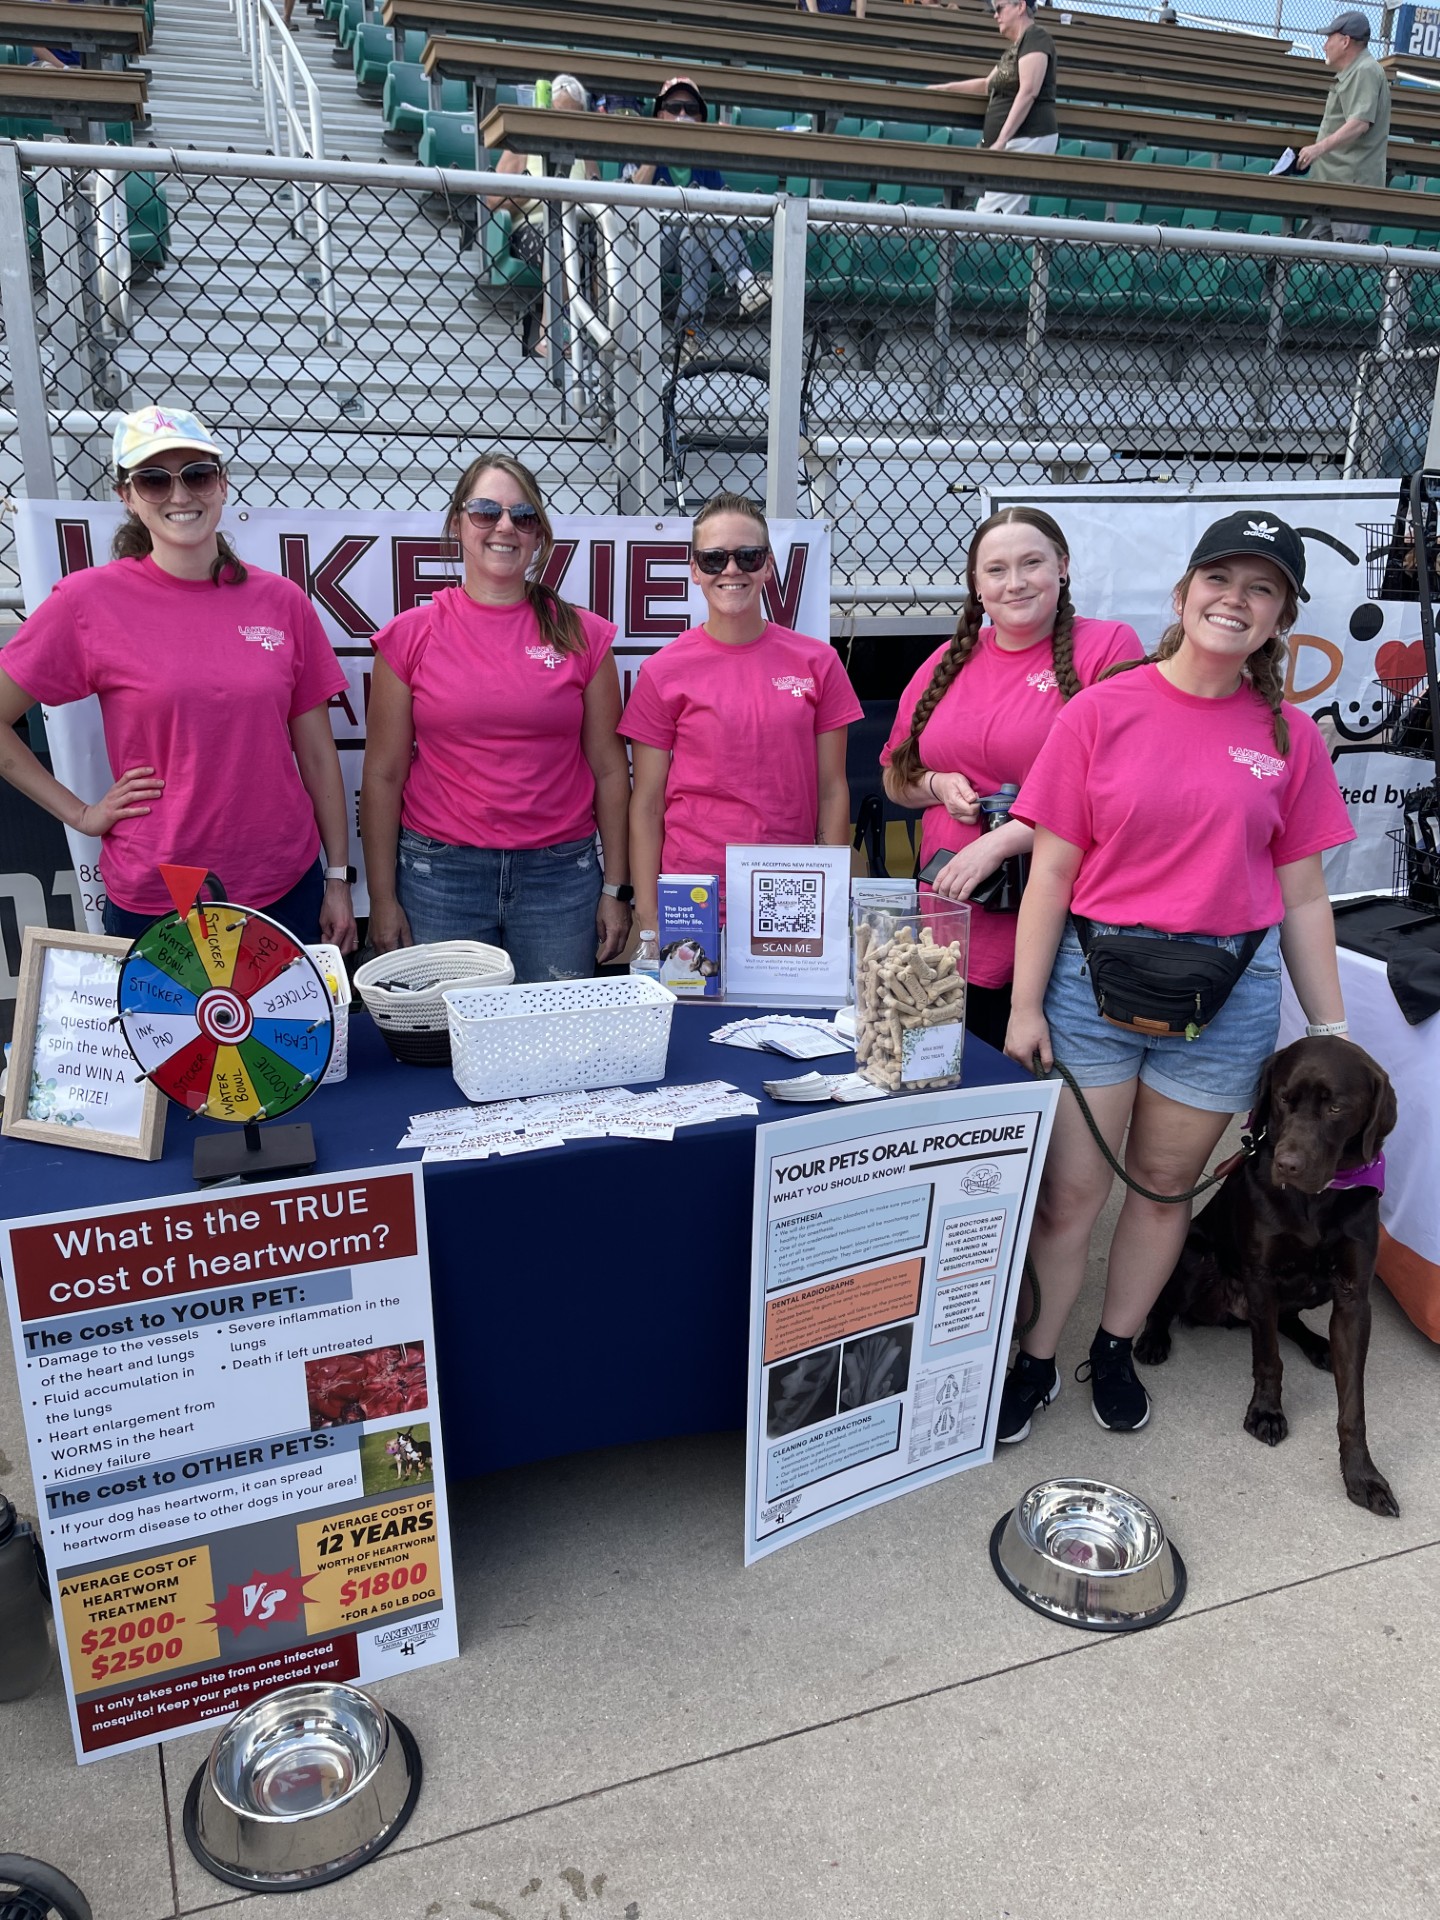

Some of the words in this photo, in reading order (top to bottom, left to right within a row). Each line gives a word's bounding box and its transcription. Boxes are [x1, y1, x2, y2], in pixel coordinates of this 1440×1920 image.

[1408, 22, 1440, 58] 20
[1243, 530, 1275, 542] adidas
[665, 918, 690, 926] healthy
[157, 948, 185, 976] BOWL
[158, 928, 194, 963] WATER
[248, 936, 278, 970] BALL
[762, 943, 792, 953] SCAN
[794, 944, 812, 953] ME
[71, 990, 118, 1008] Answer
[129, 977, 183, 1007] STICKER
[264, 981, 318, 1013] STICKER
[61, 1016, 115, 1033] question
[135, 1024, 155, 1039] INK
[153, 1032, 173, 1049] PAD
[48, 1037, 73, 1052] spin
[77, 1040, 98, 1055] the
[274, 1029, 318, 1056] LEASH
[58, 1063, 81, 1076] and
[86, 1065, 113, 1083] WIN
[116, 1070, 125, 1083] A
[233, 1068, 249, 1102] BOWL
[253, 1057, 294, 1104] KOOZIE
[69, 1086, 109, 1106] PRIZE!
[216, 1073, 235, 1115] WATER
[412, 1106, 468, 1120] LAKEVIEW
[615, 1120, 673, 1128] LAKEVIEW
[428, 1142, 488, 1152] LAKEVIEW
[496, 1130, 554, 1144] LAKEVIEW
[775, 1159, 825, 1184] YOUR
[829, 1149, 868, 1171] PETS
[872, 1140, 918, 1161] ORAL
[922, 1125, 1025, 1152] PROCEDURE
[773, 1188, 803, 1203] WHAT
[806, 1182, 828, 1194] YOU
[830, 1173, 869, 1189] SHOULD
[872, 1164, 905, 1179] KNOW!
[53, 1221, 153, 1258] What
[164, 1216, 192, 1241] is
[203, 1208, 259, 1234] the
[270, 1188, 367, 1224] TRUE
[774, 1212, 822, 1229] ANESTHESIA
[49, 1267, 130, 1302] cost
[142, 1257, 175, 1285] of
[188, 1224, 389, 1278] heartworm?
[772, 1295, 799, 1309] DENTAL
[801, 1278, 854, 1300] RADIOGRAPHS
[23, 1330, 72, 1349] The
[80, 1316, 133, 1340] cost
[140, 1313, 164, 1328] to
[171, 1296, 244, 1322] YOUR
[252, 1286, 304, 1308] PET:
[229, 1319, 275, 1333] Severe
[279, 1304, 361, 1325] inflammation
[365, 1300, 376, 1309] in
[380, 1297, 399, 1307] the
[39, 1350, 98, 1367] Damage
[102, 1346, 116, 1355] to
[121, 1341, 143, 1351] the
[147, 1330, 198, 1346] vessels
[230, 1339, 266, 1351] lungs
[232, 1354, 271, 1369] Death
[275, 1351, 283, 1361] if
[287, 1347, 308, 1359] left
[312, 1335, 372, 1354] untreated
[41, 1374, 54, 1386] of
[59, 1372, 82, 1383] the
[87, 1362, 123, 1377] heart
[128, 1356, 152, 1369] and
[157, 1350, 194, 1364] lungs
[44, 1389, 79, 1405] Fluid
[84, 1372, 178, 1397] accumulation
[182, 1367, 194, 1377] in
[46, 1413, 69, 1424] the
[73, 1404, 112, 1418] lungs
[49, 1426, 88, 1442] Heart
[93, 1407, 180, 1433] enlargement
[184, 1401, 214, 1413] from
[51, 1439, 112, 1460] WORMS
[116, 1437, 128, 1447] in
[132, 1432, 155, 1443] the
[159, 1422, 193, 1437] heart
[772, 1439, 807, 1457] CLEANING
[809, 1433, 823, 1443] AND
[825, 1415, 871, 1437] EXTRACTIONS
[47, 1491, 90, 1508] The
[97, 1475, 146, 1498] cost
[152, 1471, 175, 1485] to
[182, 1448, 263, 1478] OTHER
[270, 1433, 334, 1459] PETS:
[54, 1462, 102, 1479] Kidney
[107, 1452, 150, 1467] failure
[61, 1523, 69, 1533] If
[74, 1518, 103, 1532] your
[108, 1511, 133, 1523] dog
[137, 1505, 160, 1516] has
[164, 1488, 237, 1509] heartworm,
[242, 1482, 250, 1492] it
[254, 1478, 276, 1489] can
[280, 1465, 322, 1484] spread
[322, 1512, 377, 1533] AVERAGE
[381, 1503, 413, 1518] COST
[417, 1499, 432, 1509] OF
[317, 1533, 343, 1556] 12
[350, 1511, 433, 1547] YEARS
[318, 1556, 354, 1570] WORTH
[357, 1551, 369, 1561] OF
[372, 1535, 435, 1556] HEARTWORM
[347, 1553, 408, 1575] PREVENTION
[60, 1571, 129, 1597] AVERAGE
[133, 1561, 173, 1578] COST
[177, 1555, 196, 1567] OF
[83, 1576, 178, 1607] HEARTWORM
[339, 1563, 427, 1606] $1800
[88, 1592, 176, 1622] TREATMENT
[381, 1601, 393, 1610] 50
[396, 1596, 409, 1606] LB
[412, 1589, 435, 1601] DOG
[81, 1612, 185, 1655] $2000-
[374, 1617, 439, 1645] LAKEVIEW
[91, 1637, 182, 1680] $2500
